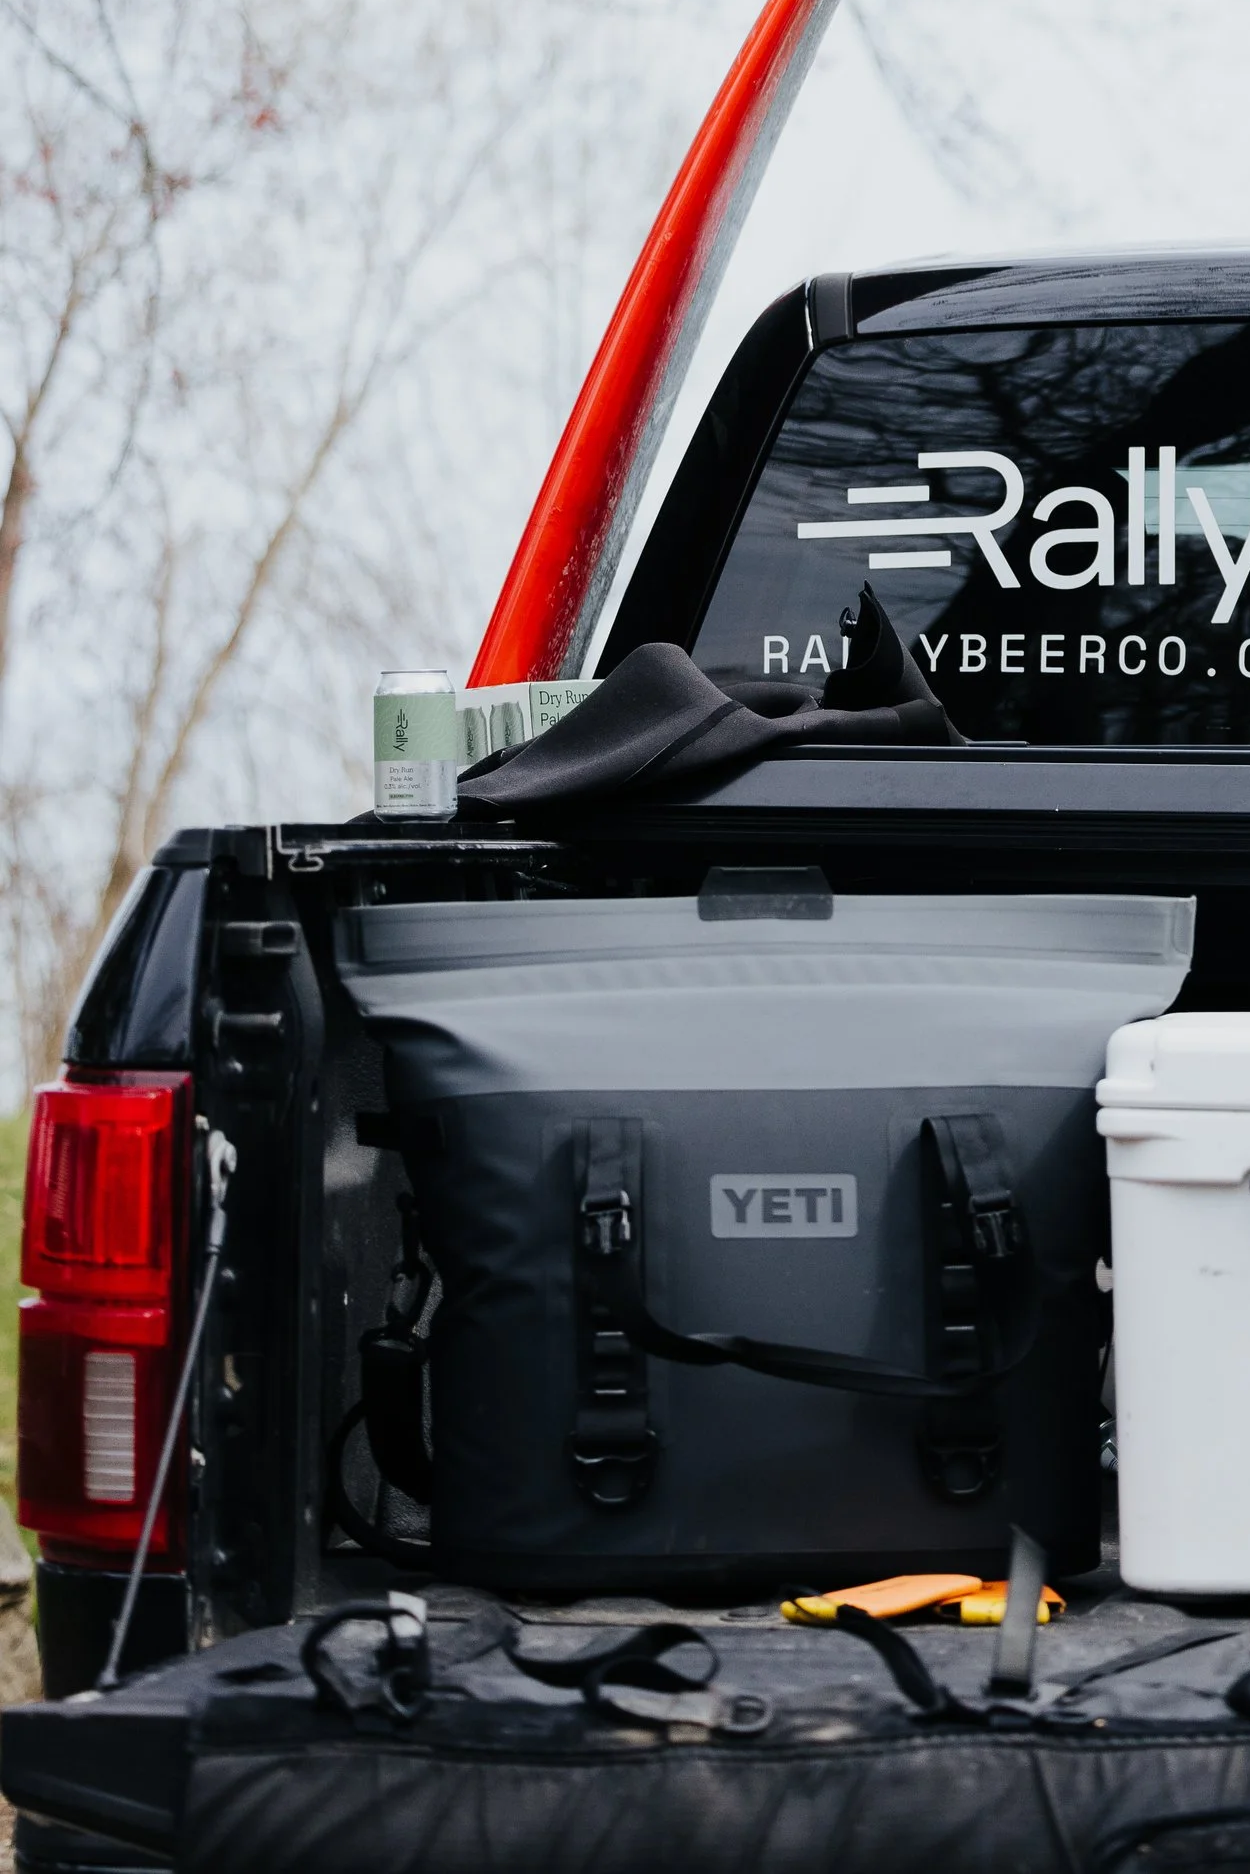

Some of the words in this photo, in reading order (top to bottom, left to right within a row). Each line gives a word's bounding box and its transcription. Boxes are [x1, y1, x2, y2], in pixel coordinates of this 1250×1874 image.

[539, 690, 562, 708] Dry
[393, 708, 408, 752] Rally
[540, 712, 566, 726] Pal
[722, 1188, 844, 1224] YETI
